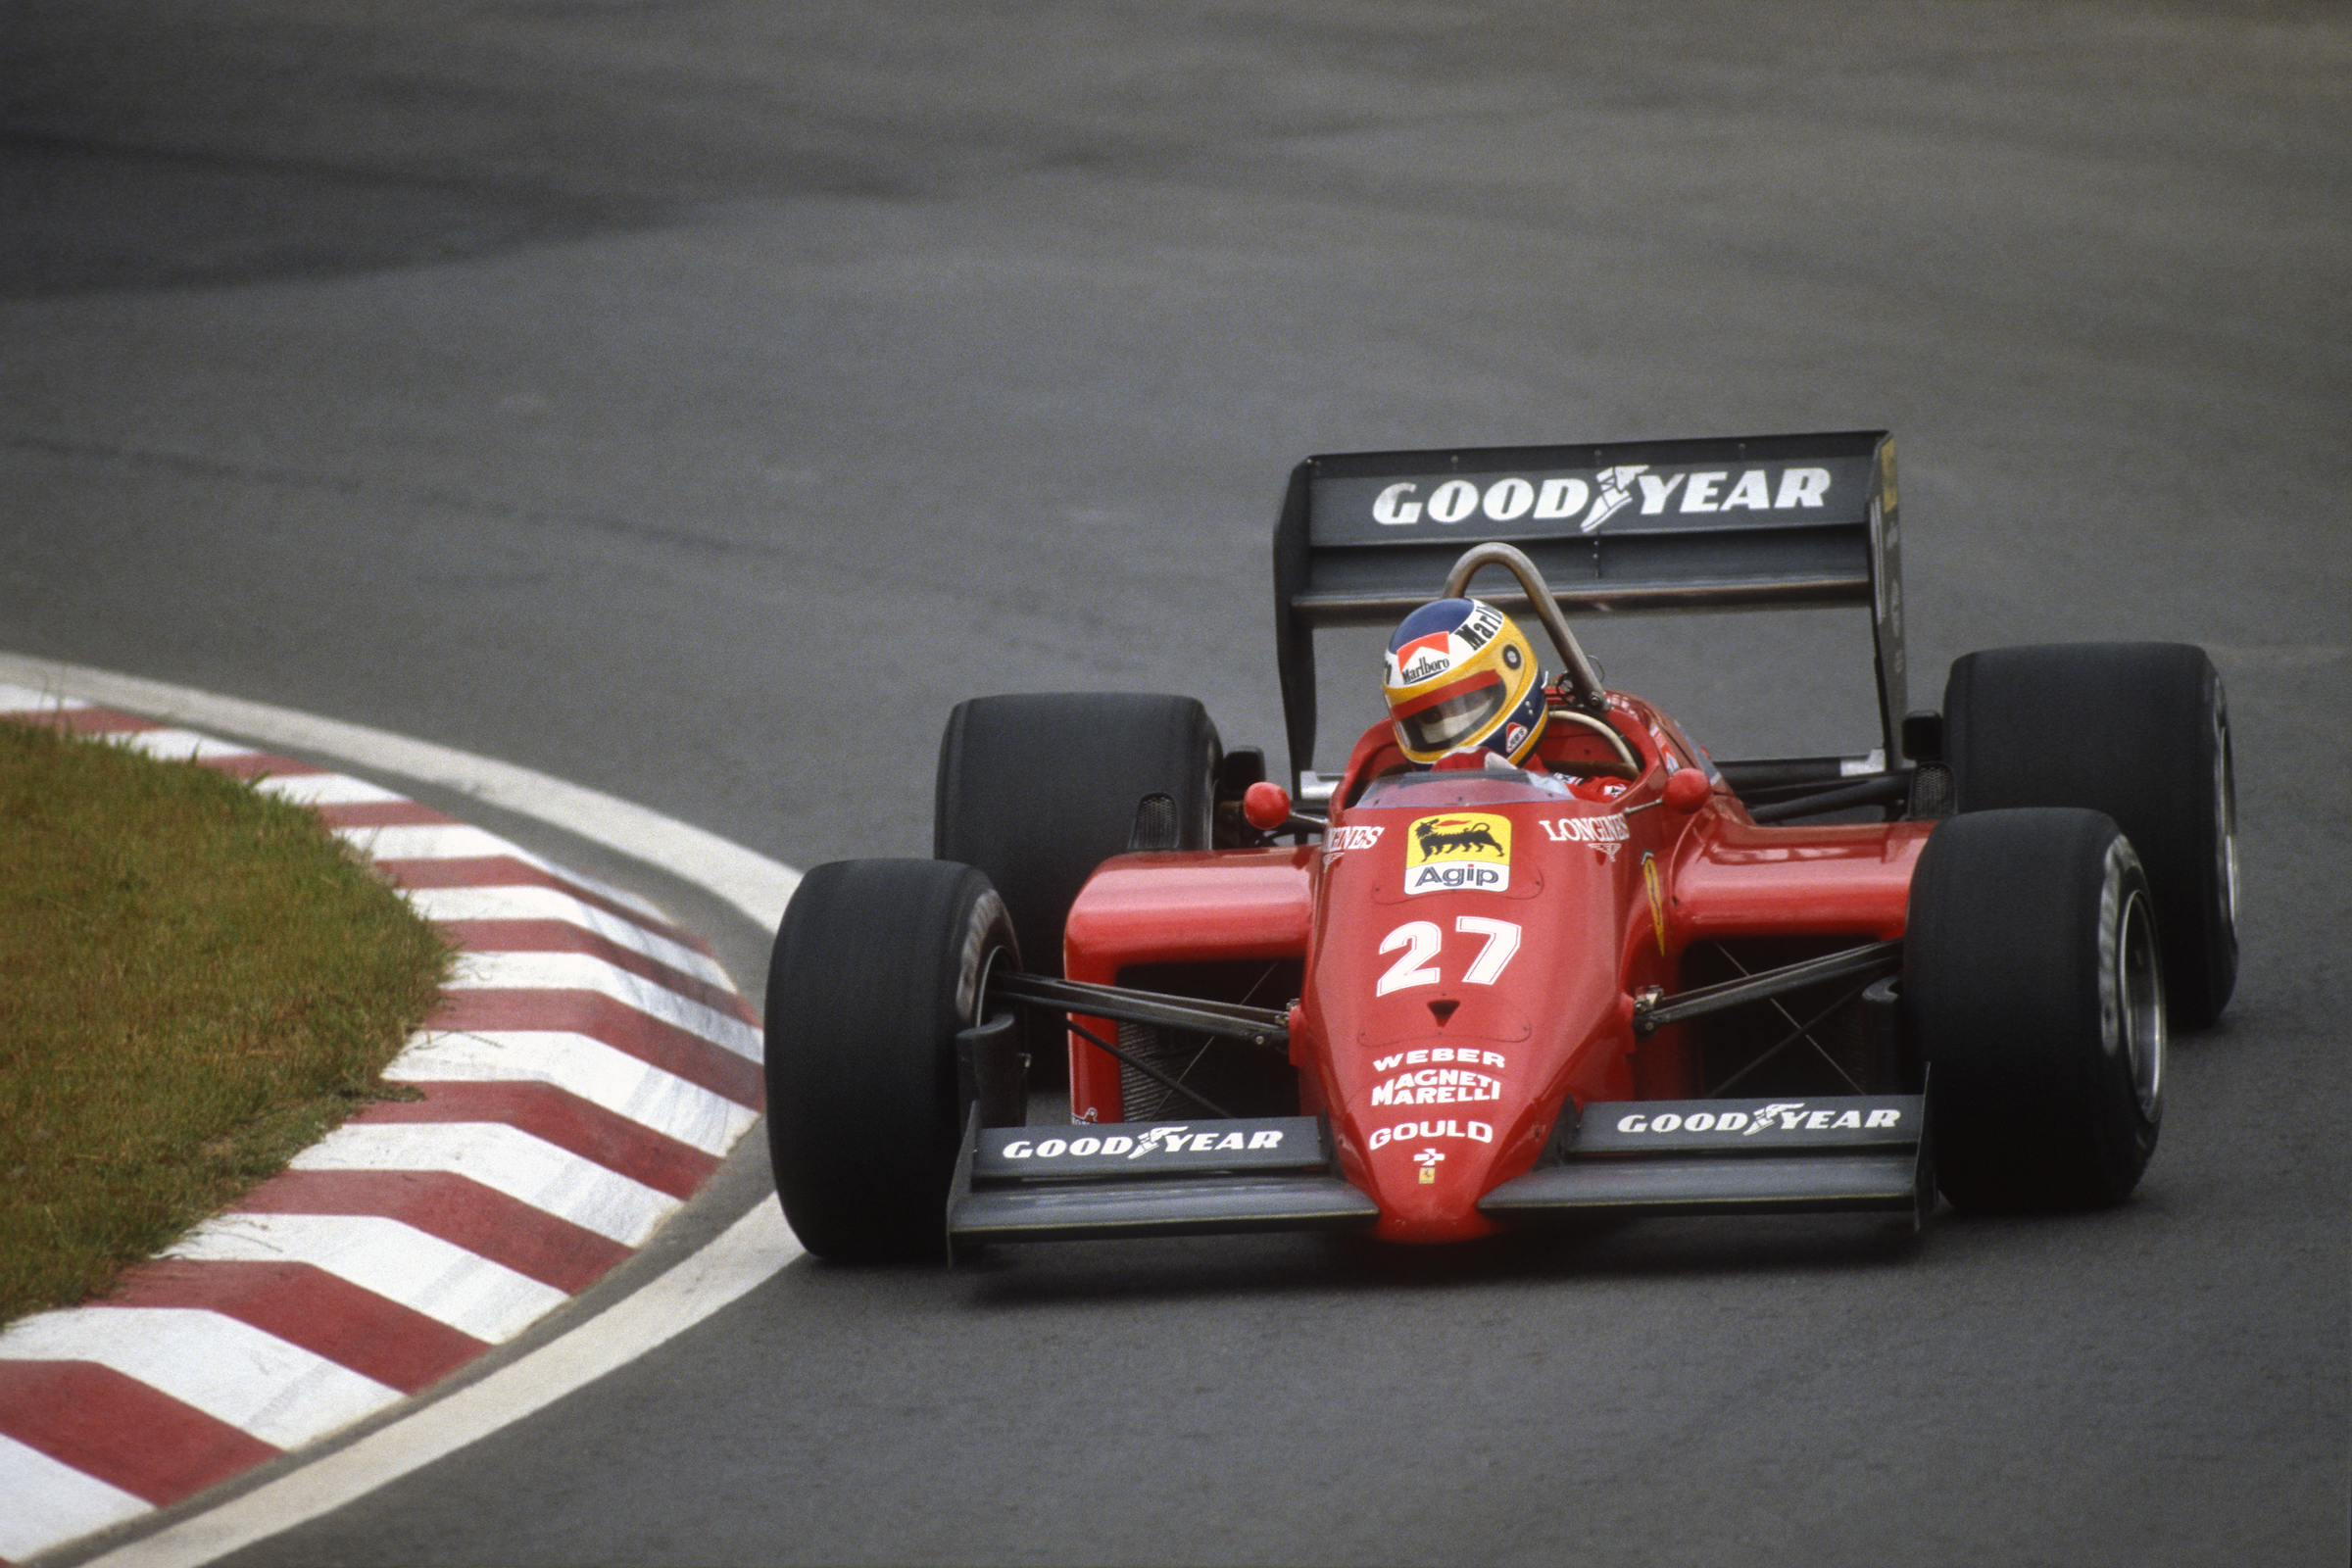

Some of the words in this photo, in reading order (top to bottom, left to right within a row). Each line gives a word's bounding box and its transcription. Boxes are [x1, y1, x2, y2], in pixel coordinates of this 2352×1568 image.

[1401, 656, 1450, 684] Marlboro
[1539, 812, 1631, 842] LONGINES
[1414, 863, 1499, 888] Agip
[1376, 915, 1522, 998] 27
[1373, 1048, 1505, 1072] WEBER
[1372, 1069, 1500, 1096] MAGNETI
[1372, 1082, 1500, 1106] MARELLI
[1369, 1120, 1493, 1151] GOULD
